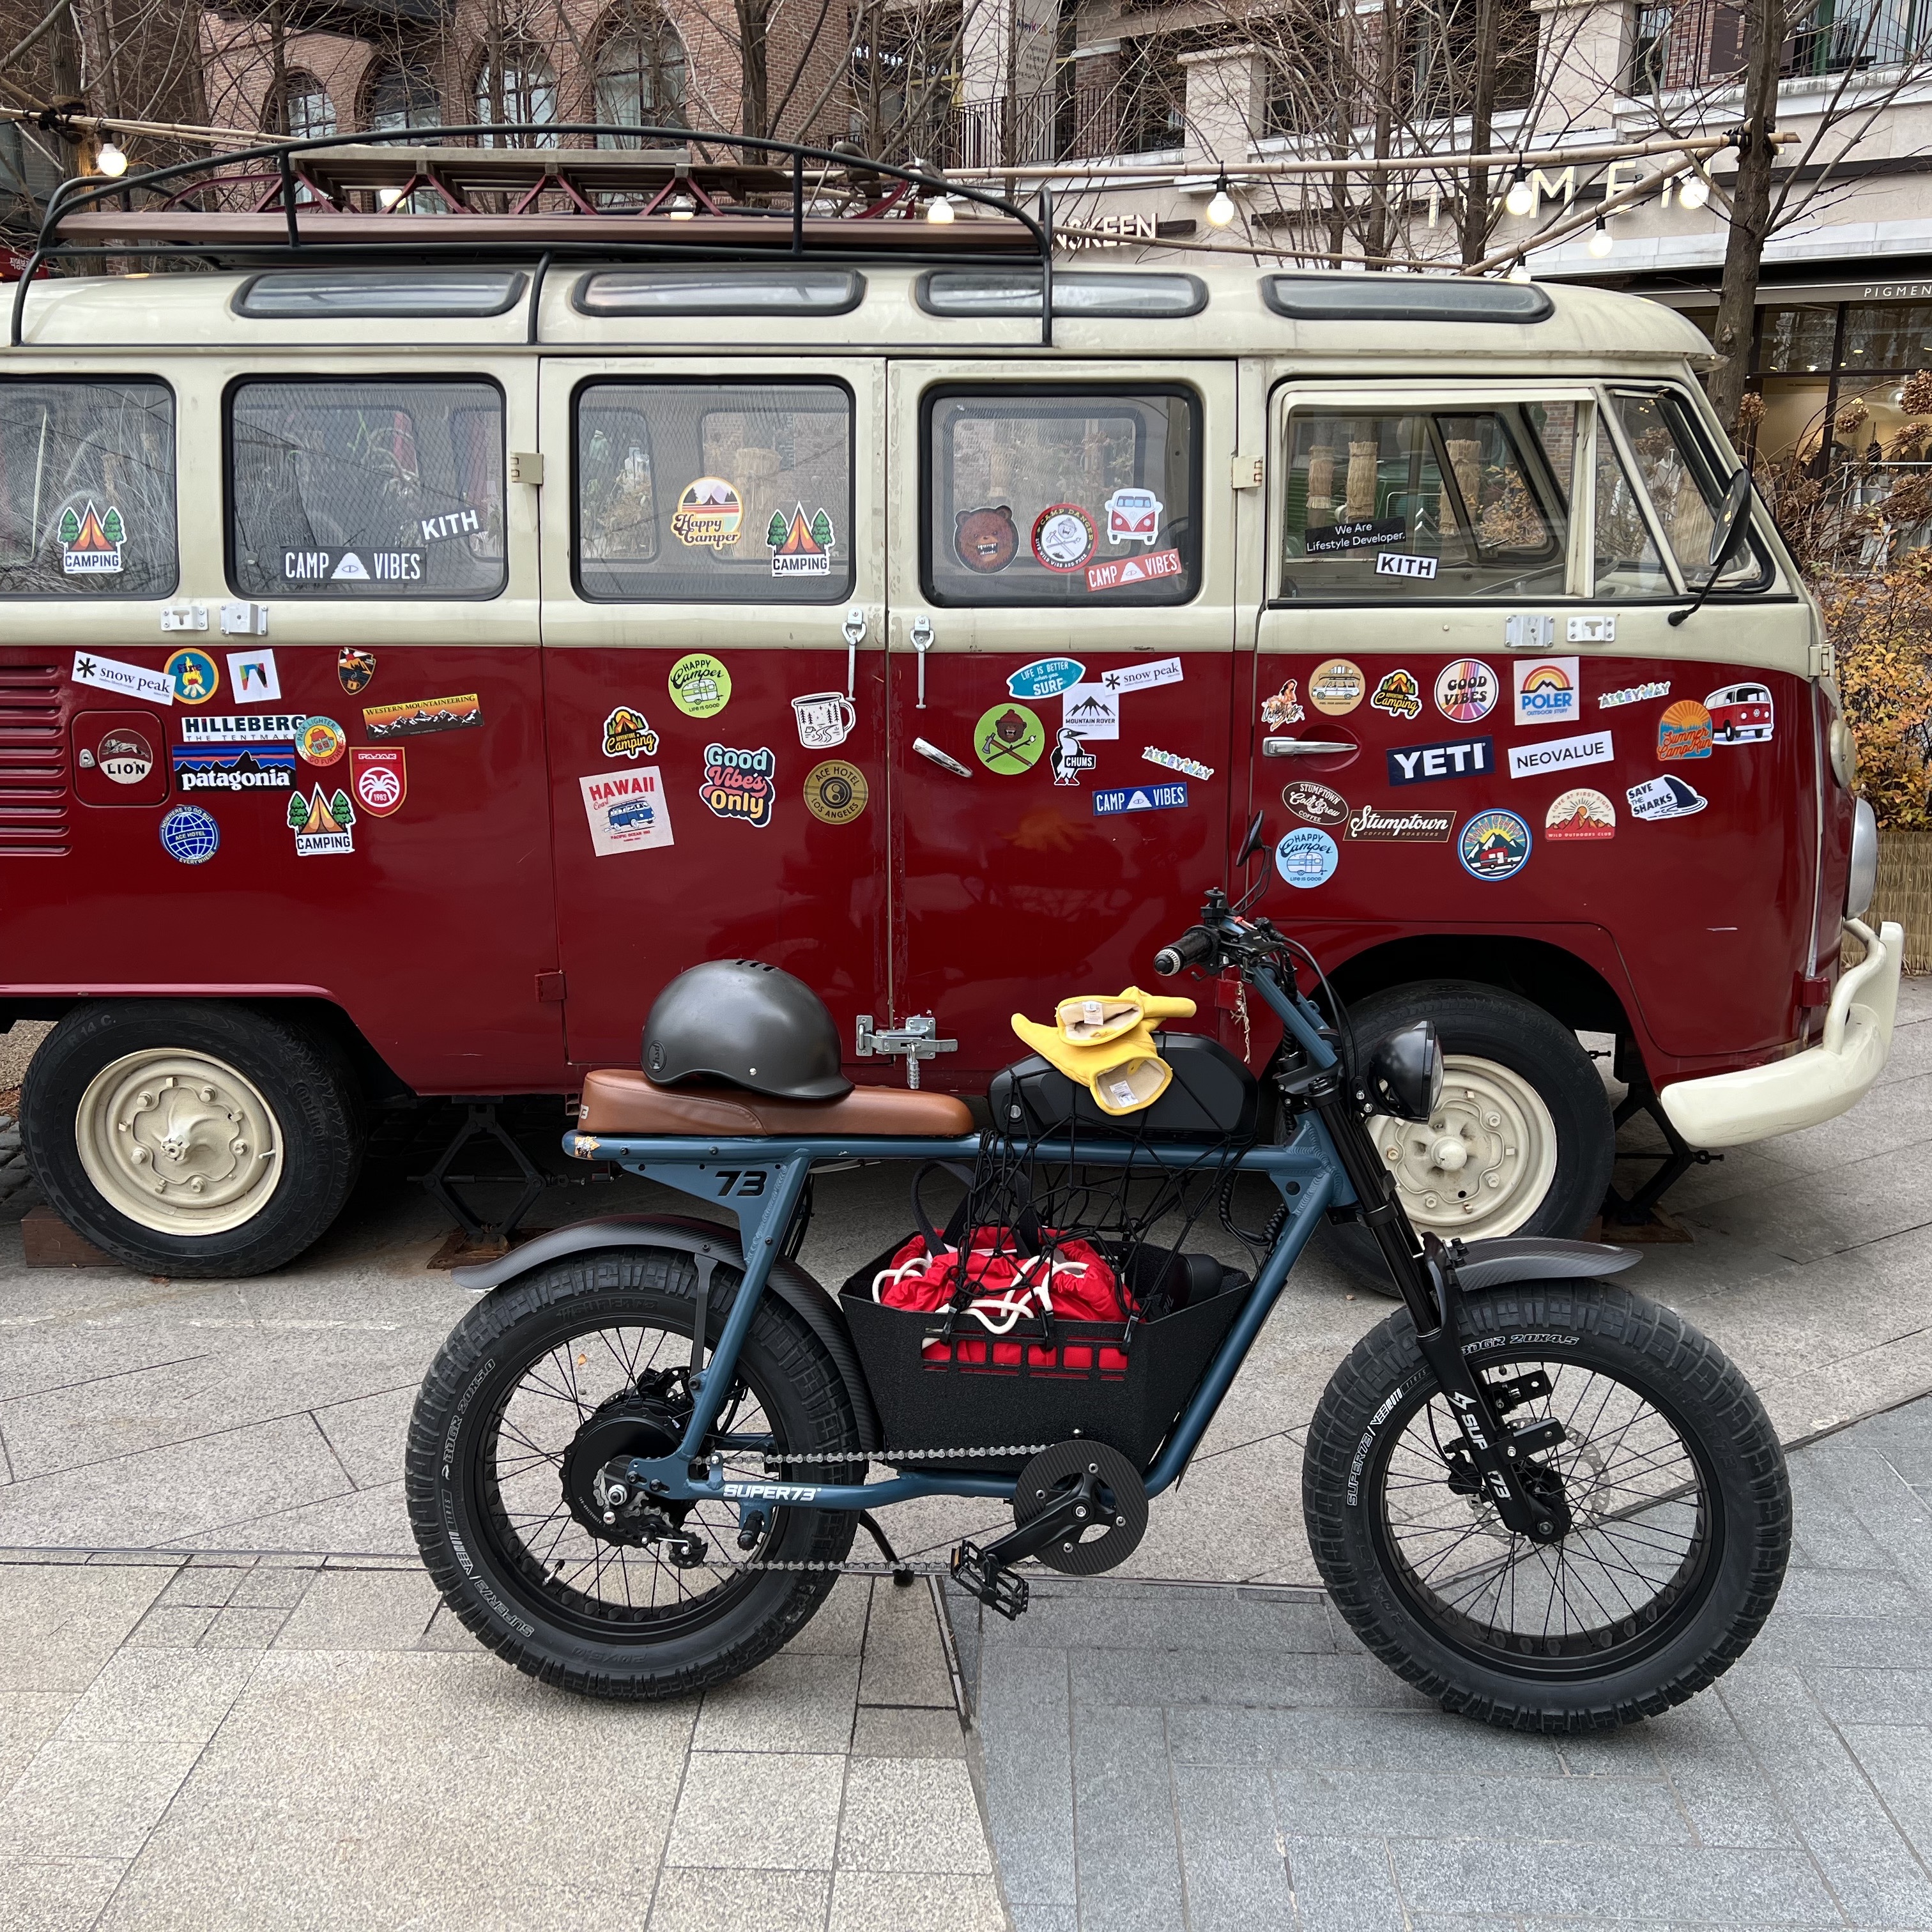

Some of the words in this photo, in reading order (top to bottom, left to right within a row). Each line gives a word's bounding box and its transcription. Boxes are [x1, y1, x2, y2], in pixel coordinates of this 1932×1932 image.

[421, 509, 479, 540] KITH
[673, 514, 723, 535] Happy
[1041, 509, 1064, 525] CAMP
[1068, 509, 1094, 540] DANGER
[1335, 524, 1353, 535] We
[1354, 523, 1372, 532] Are
[684, 528, 739, 548] Camper
[1307, 538, 1350, 551] Lifestyle
[65, 554, 119, 567] CAMPING
[286, 551, 330, 579] CAMP
[373, 552, 421, 579] VIBES
[773, 557, 827, 571] CAMPING
[1088, 566, 1118, 588] CAMP
[1145, 553, 1178, 576] VIBES
[1381, 556, 1432, 576] KITH
[682, 659, 711, 672] HAPPY
[1020, 670, 1035, 680] LIFE
[1046, 661, 1069, 673] BETTER
[1124, 671, 1151, 683] snow
[1154, 662, 1180, 680] peak
[100, 666, 135, 684] snow
[136, 677, 171, 694] peak
[670, 668, 724, 689] Camper
[1032, 678, 1064, 696] SURF
[1447, 676, 1487, 691] GOOD
[365, 704, 404, 716] WESTERN
[404, 695, 476, 710] MOUNTAINEERING
[1375, 692, 1418, 715] Camping
[1444, 690, 1487, 705] VIBES
[1521, 693, 1573, 710] POLER
[296, 724, 307, 741] PACK
[307, 717, 336, 728] LIGHTER
[1664, 726, 1709, 746] Summer
[607, 735, 655, 754] Camping
[1517, 740, 1606, 769] NEOVALUE
[321, 745, 344, 765] FURTHER
[708, 746, 767, 770] Good
[1066, 756, 1092, 767] CHUMS
[1394, 742, 1485, 779] YETI
[107, 762, 146, 774] LION
[815, 767, 831, 782] ACE
[833, 767, 860, 787] HOTEL
[181, 769, 291, 791] patagonia
[588, 776, 656, 801] HAWAII
[1096, 793, 1125, 811] CAMP
[1153, 786, 1184, 806] VIBES
[1300, 783, 1340, 805] STUMPTOWN
[1629, 783, 1653, 799] SAVE
[1630, 796, 1644, 806] THE
[710, 790, 764, 818] Only
[811, 798, 825, 813] LOS
[825, 802, 859, 818] ANGELES
[1552, 798, 1565, 813] LOVE
[1596, 795, 1612, 811] SIGHT
[1633, 793, 1673, 815] SHARKS
[161, 807, 183, 829] NOWHERE
[1298, 809, 1322, 823] COFFEE
[1351, 805, 1449, 838] Stumptown
[296, 836, 351, 850] CAMPING
[1279, 838, 1334, 858] Camper
[1294, 833, 1324, 843] HAPPY
[715, 1170, 768, 1197] 73
[1347, 1432, 1373, 1506] SUPER73
[1406, 1368, 1427, 1390] TIRES
[723, 1483, 817, 1501] SUPER73
[473, 1579, 535, 1638] SUPER73
